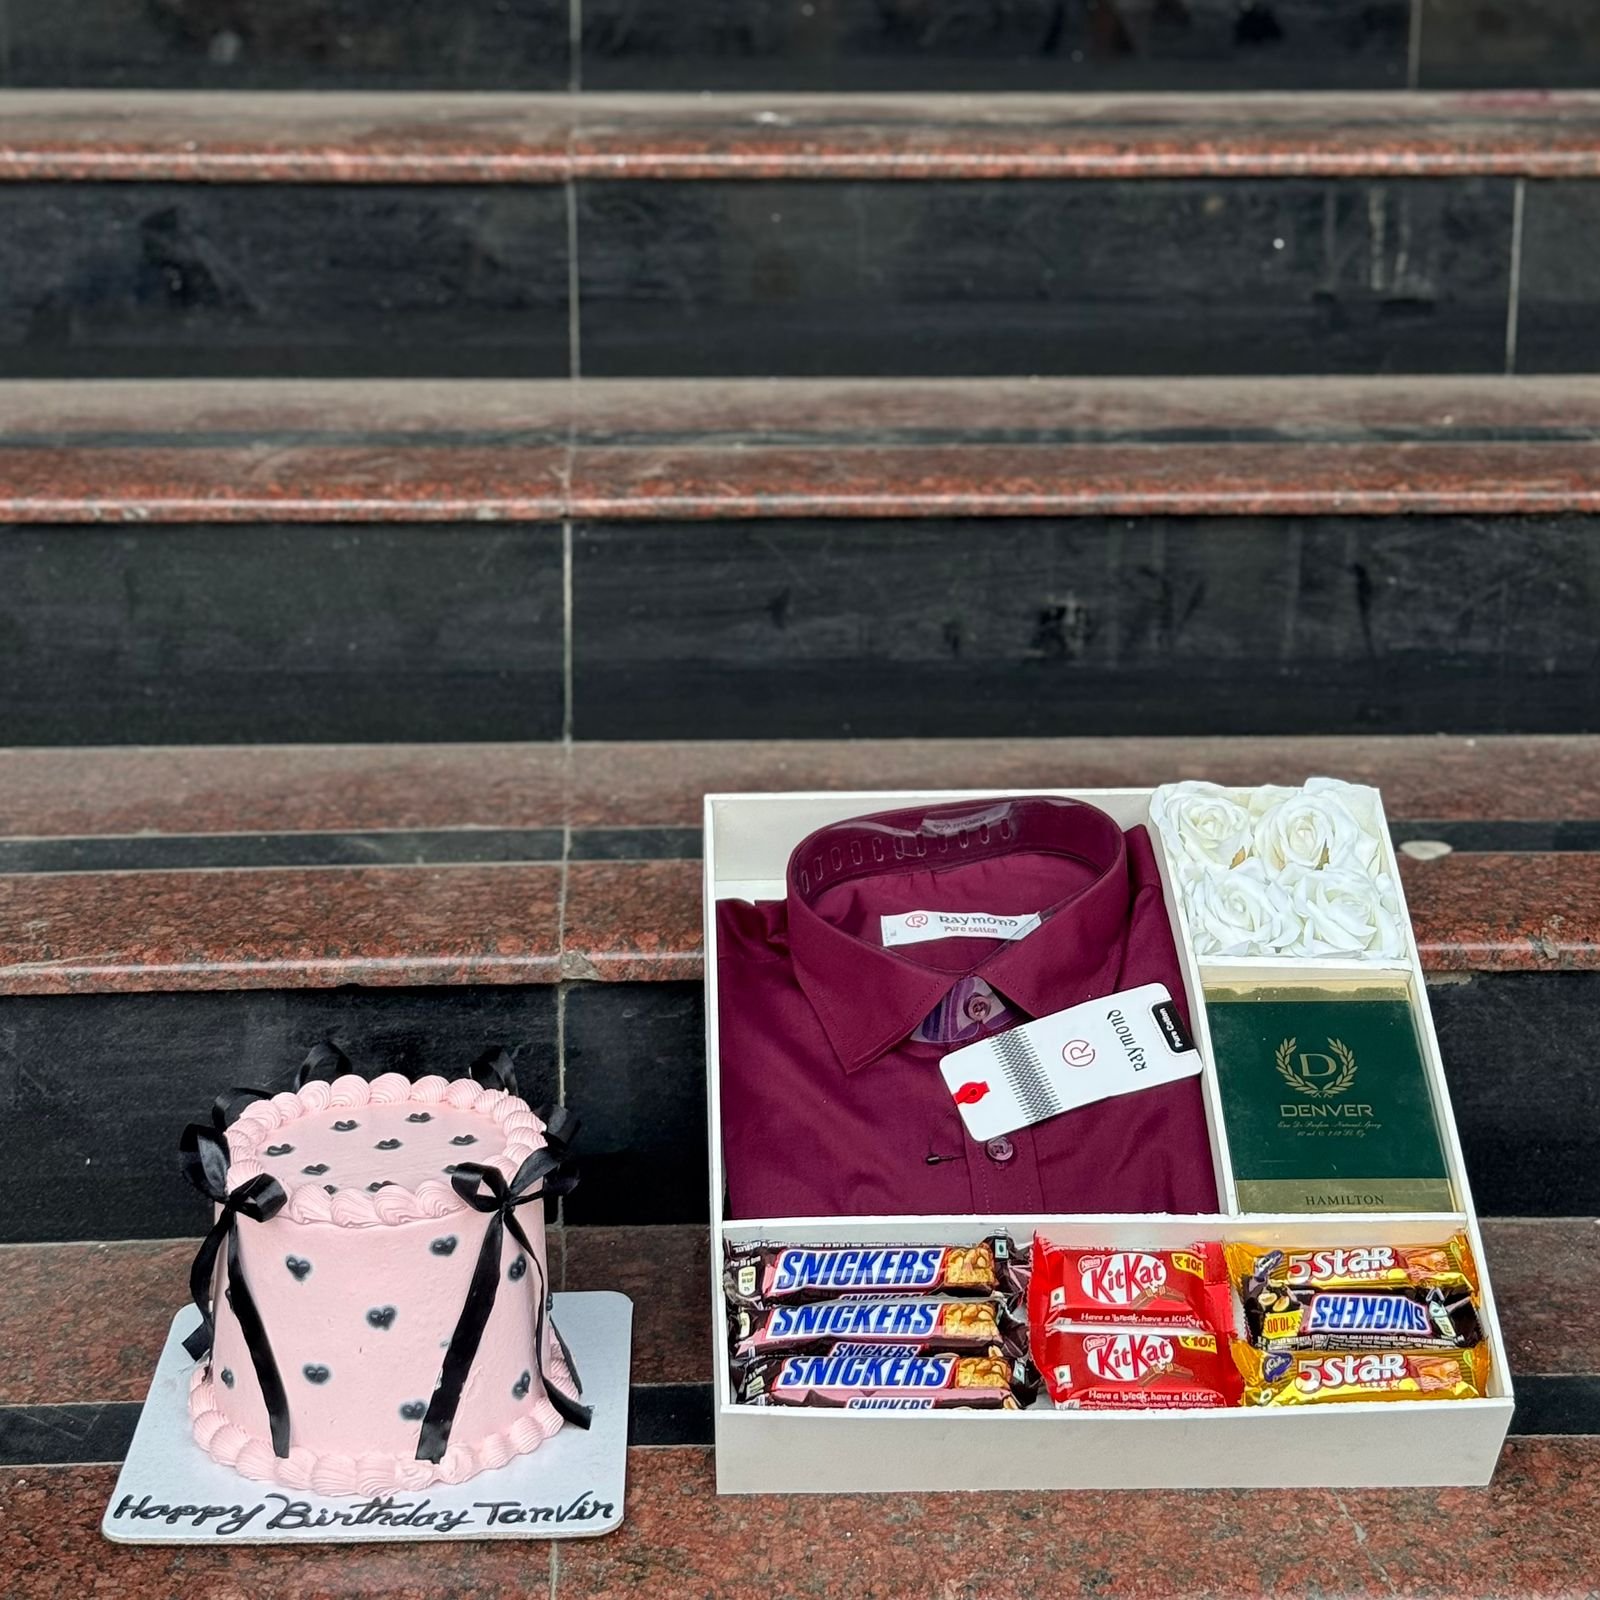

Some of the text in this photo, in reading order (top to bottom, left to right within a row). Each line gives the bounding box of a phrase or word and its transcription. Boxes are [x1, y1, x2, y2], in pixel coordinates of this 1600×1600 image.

[939, 914, 1018, 928] Raymond
[1106, 1009, 1147, 1072] Raymond
[1299, 1053, 1337, 1077] D
[1280, 1104, 1374, 1117] DENVER
[1305, 1195, 1385, 1206] HAMILTON
[775, 1248, 942, 1290] SNICKERS
[1091, 1254, 1163, 1303] KitKat
[771, 1304, 938, 1336] SNICKERS
[1311, 1295, 1428, 1332] SNICKERS
[832, 1343, 918, 1358] SNICKERS
[1096, 1335, 1170, 1379] KitKat
[781, 1357, 950, 1386] SNICKERS
[113, 1494, 266, 1535] Happy
[265, 1493, 475, 1532] Birthday
